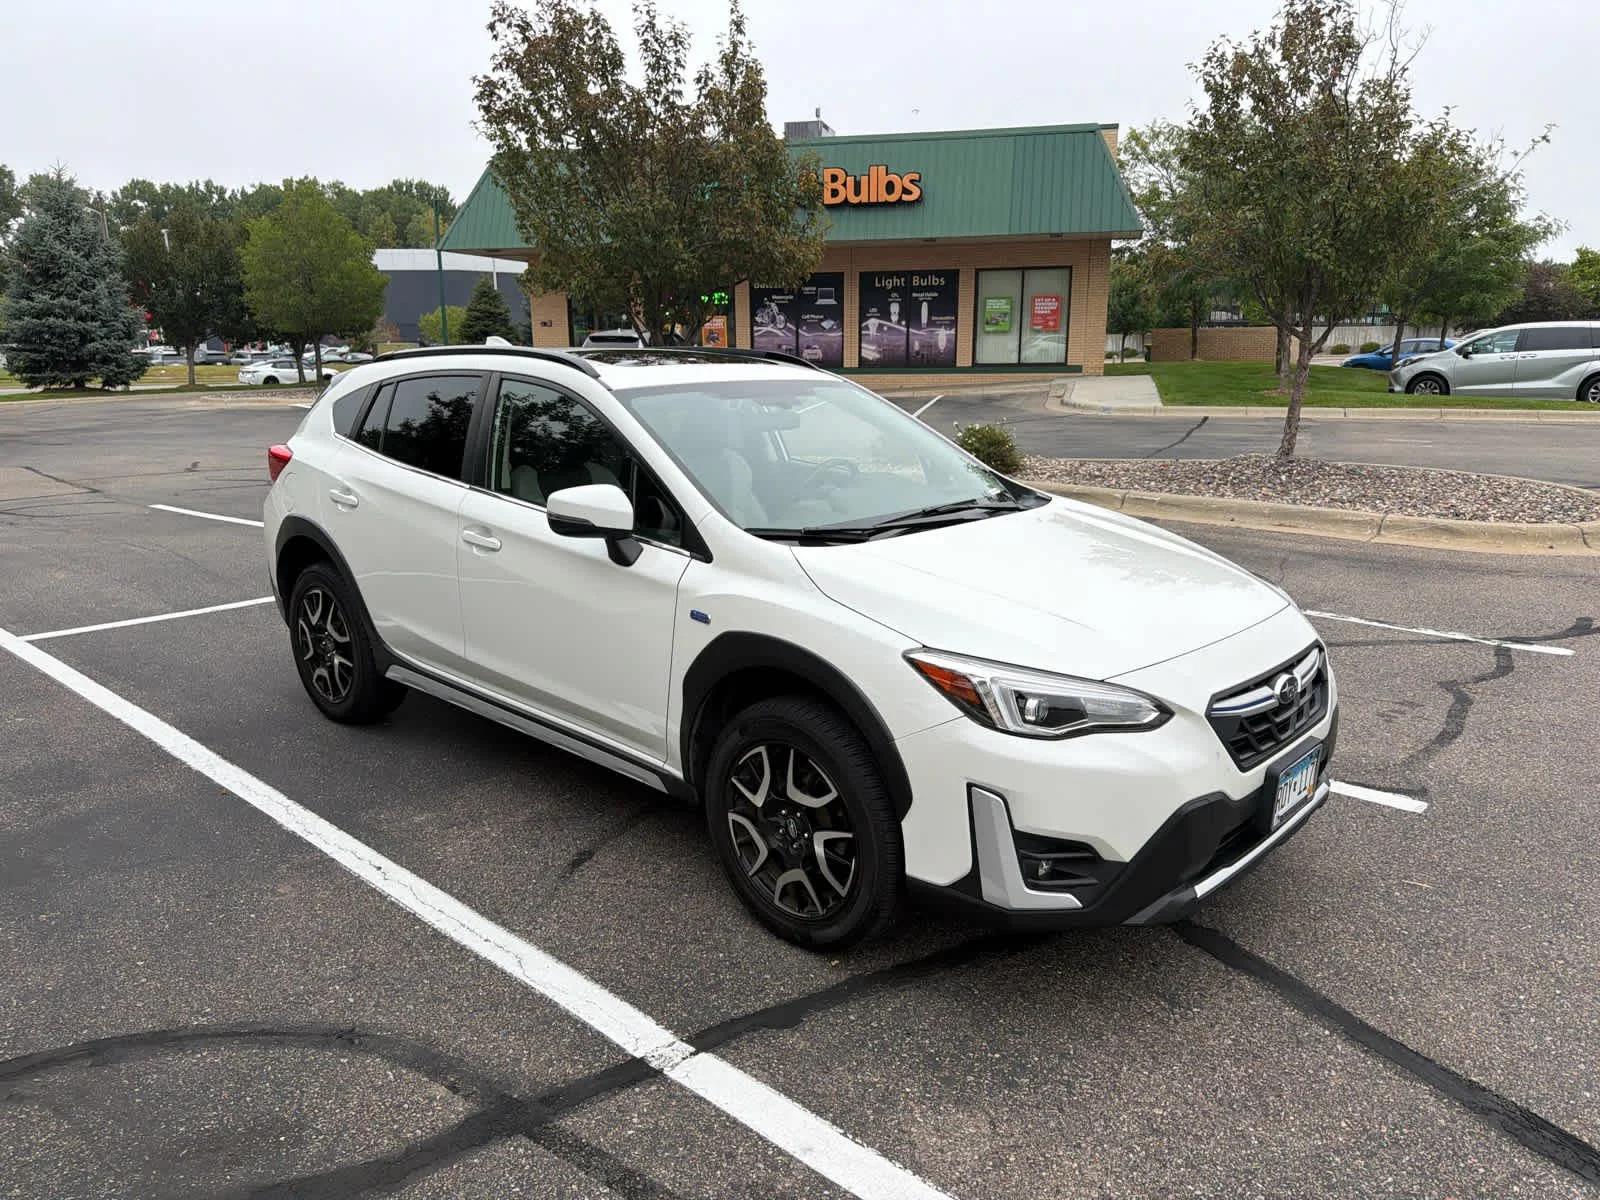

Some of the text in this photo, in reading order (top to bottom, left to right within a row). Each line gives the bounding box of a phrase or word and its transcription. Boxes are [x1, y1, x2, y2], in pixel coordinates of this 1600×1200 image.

[823, 165, 921, 205] Bulbs
[875, 274, 945, 289] Light Bulbs
